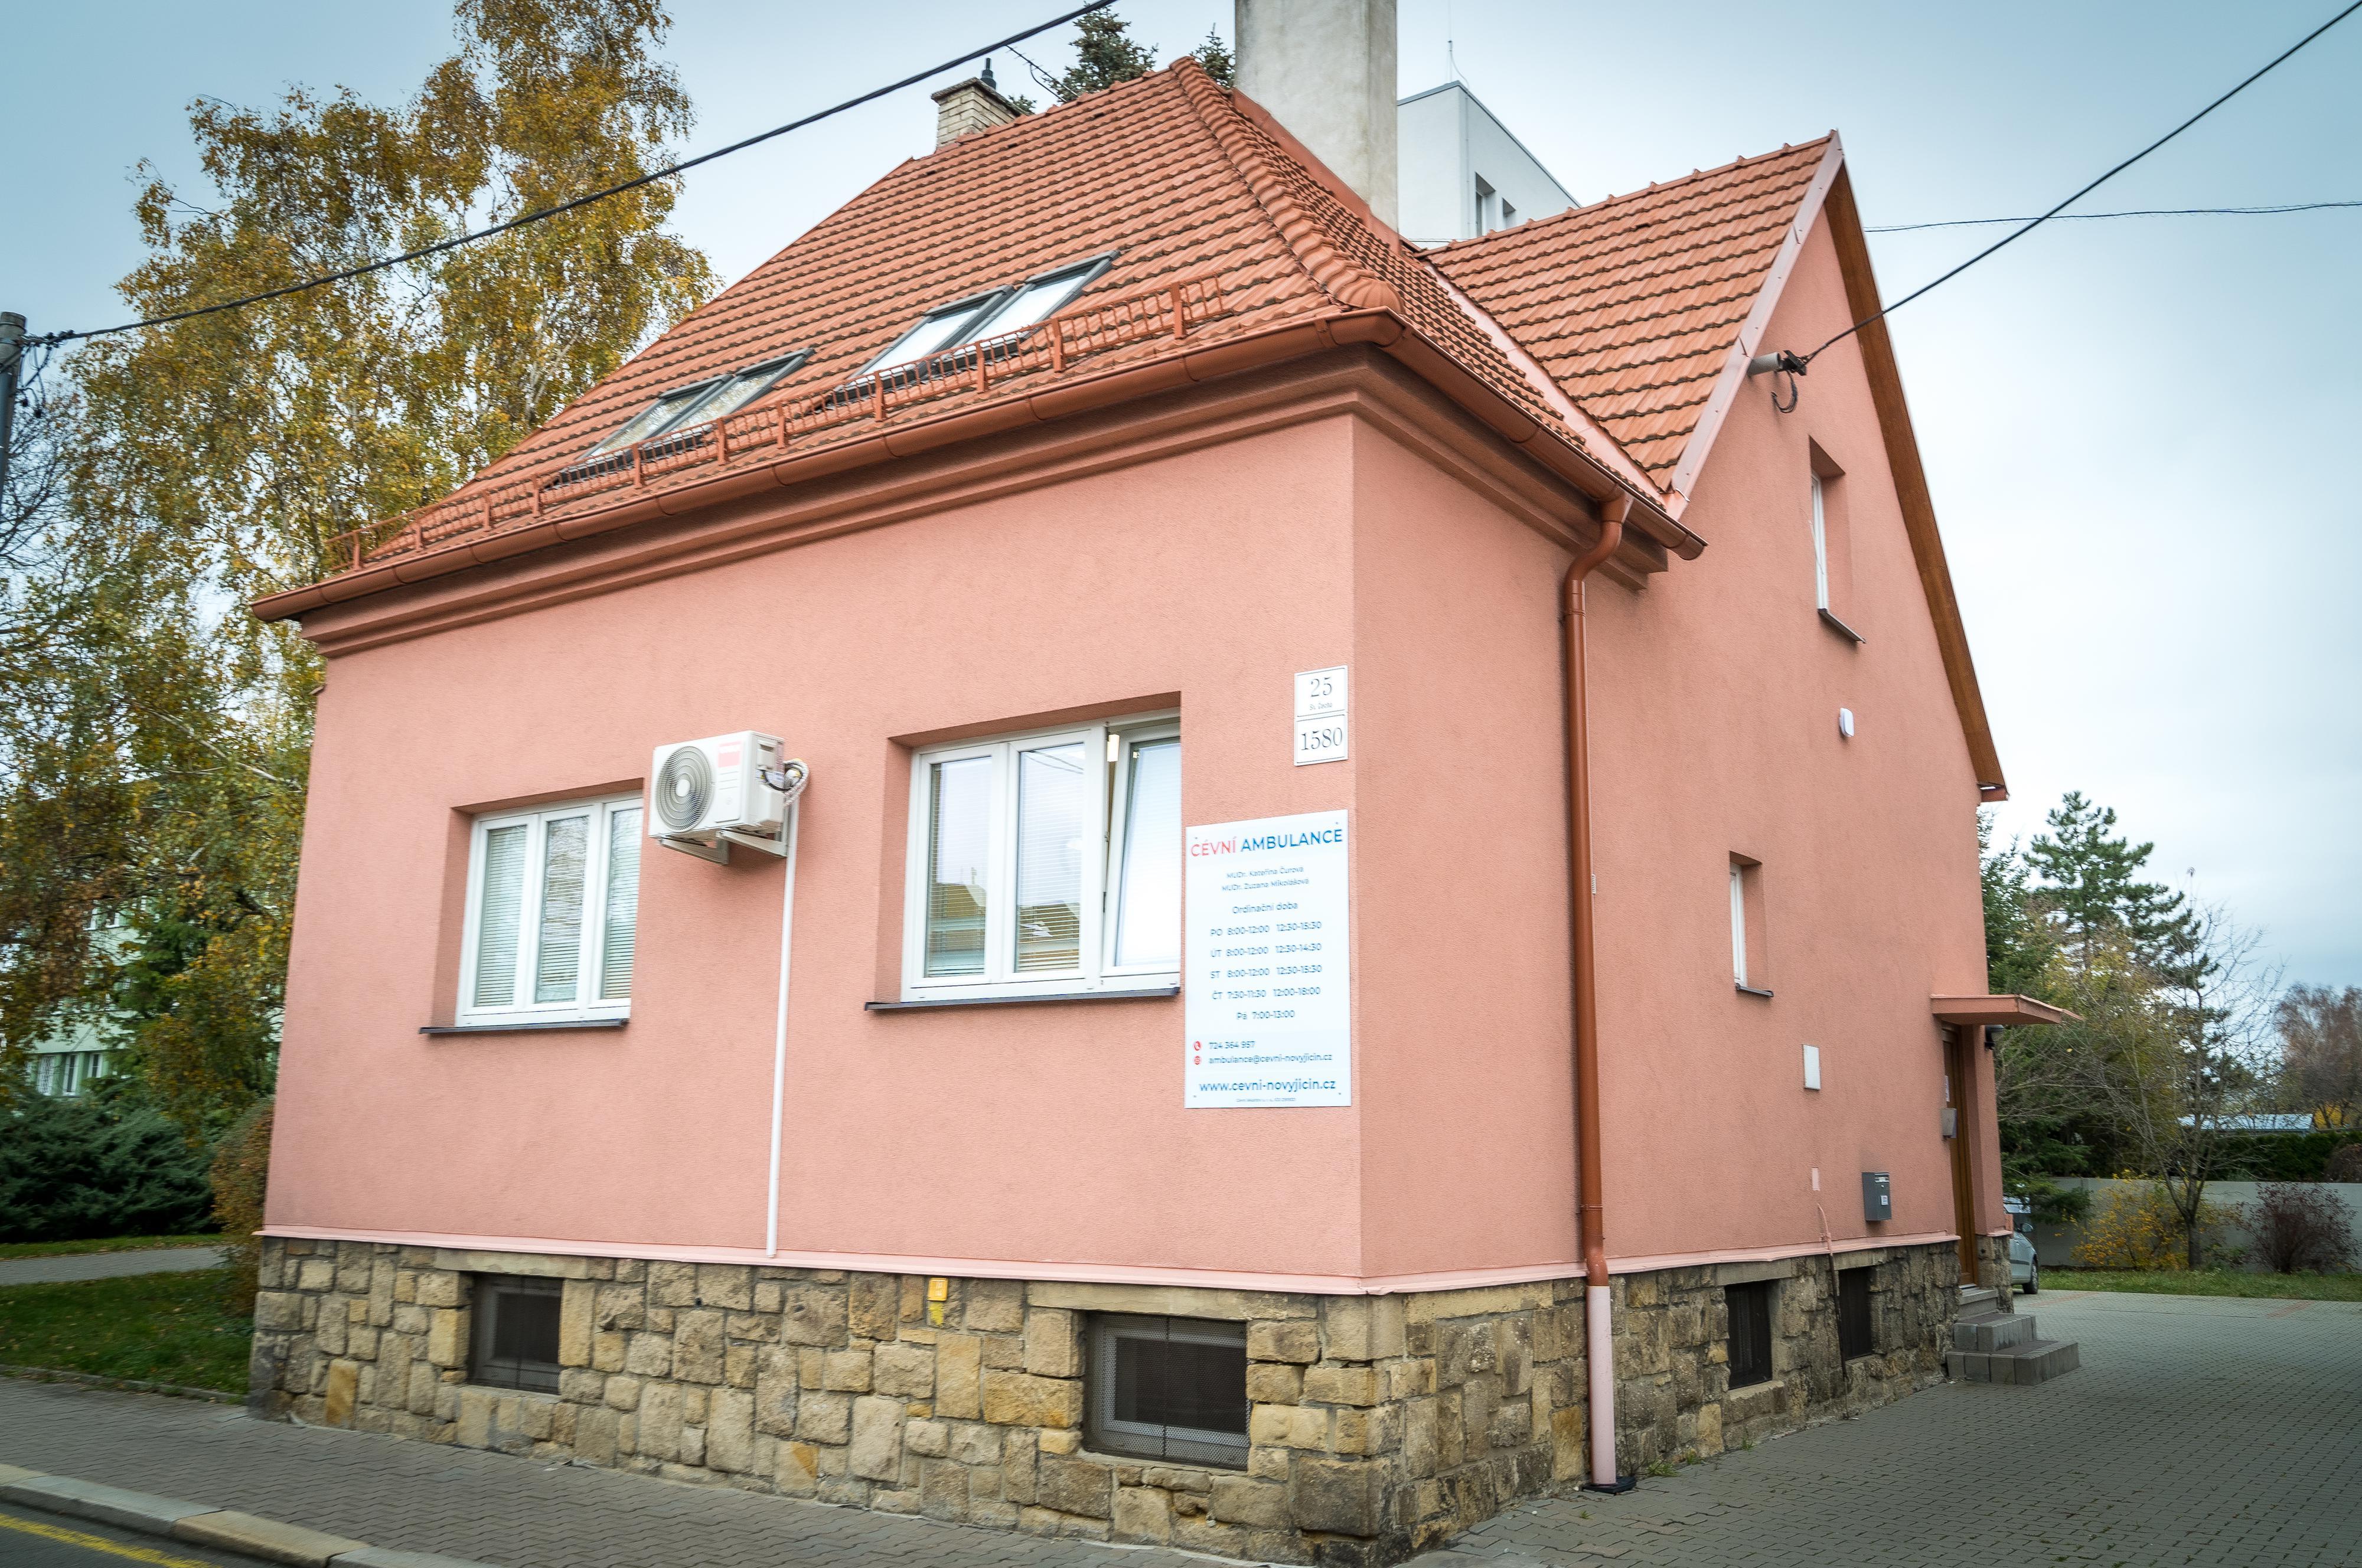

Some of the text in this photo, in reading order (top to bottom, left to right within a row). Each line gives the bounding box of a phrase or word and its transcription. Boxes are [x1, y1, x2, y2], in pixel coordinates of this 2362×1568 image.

[1310, 677, 1332, 697] 25
[1301, 727, 1343, 750] 1580
[1190, 828, 1343, 857] CÉVNÍ AMBULANCE
[1232, 903, 1274, 914] Ordinační
[1227, 925, 1270, 935] 8:00-12:00
[1275, 921, 1322, 932] 12:30-15:30
[1226, 947, 1269, 956] 8:00-12:00
[1210, 964, 1322, 979] ST 8:00-12:00 12:30-15:30
[1212, 986, 1321, 999] ČT 7:30-11:30 12:00-18:00
[1252, 1010, 1295, 1019] 7:00-13:00
[1199, 1078, 1336, 1092] www.cevni-novyjicin.cz
